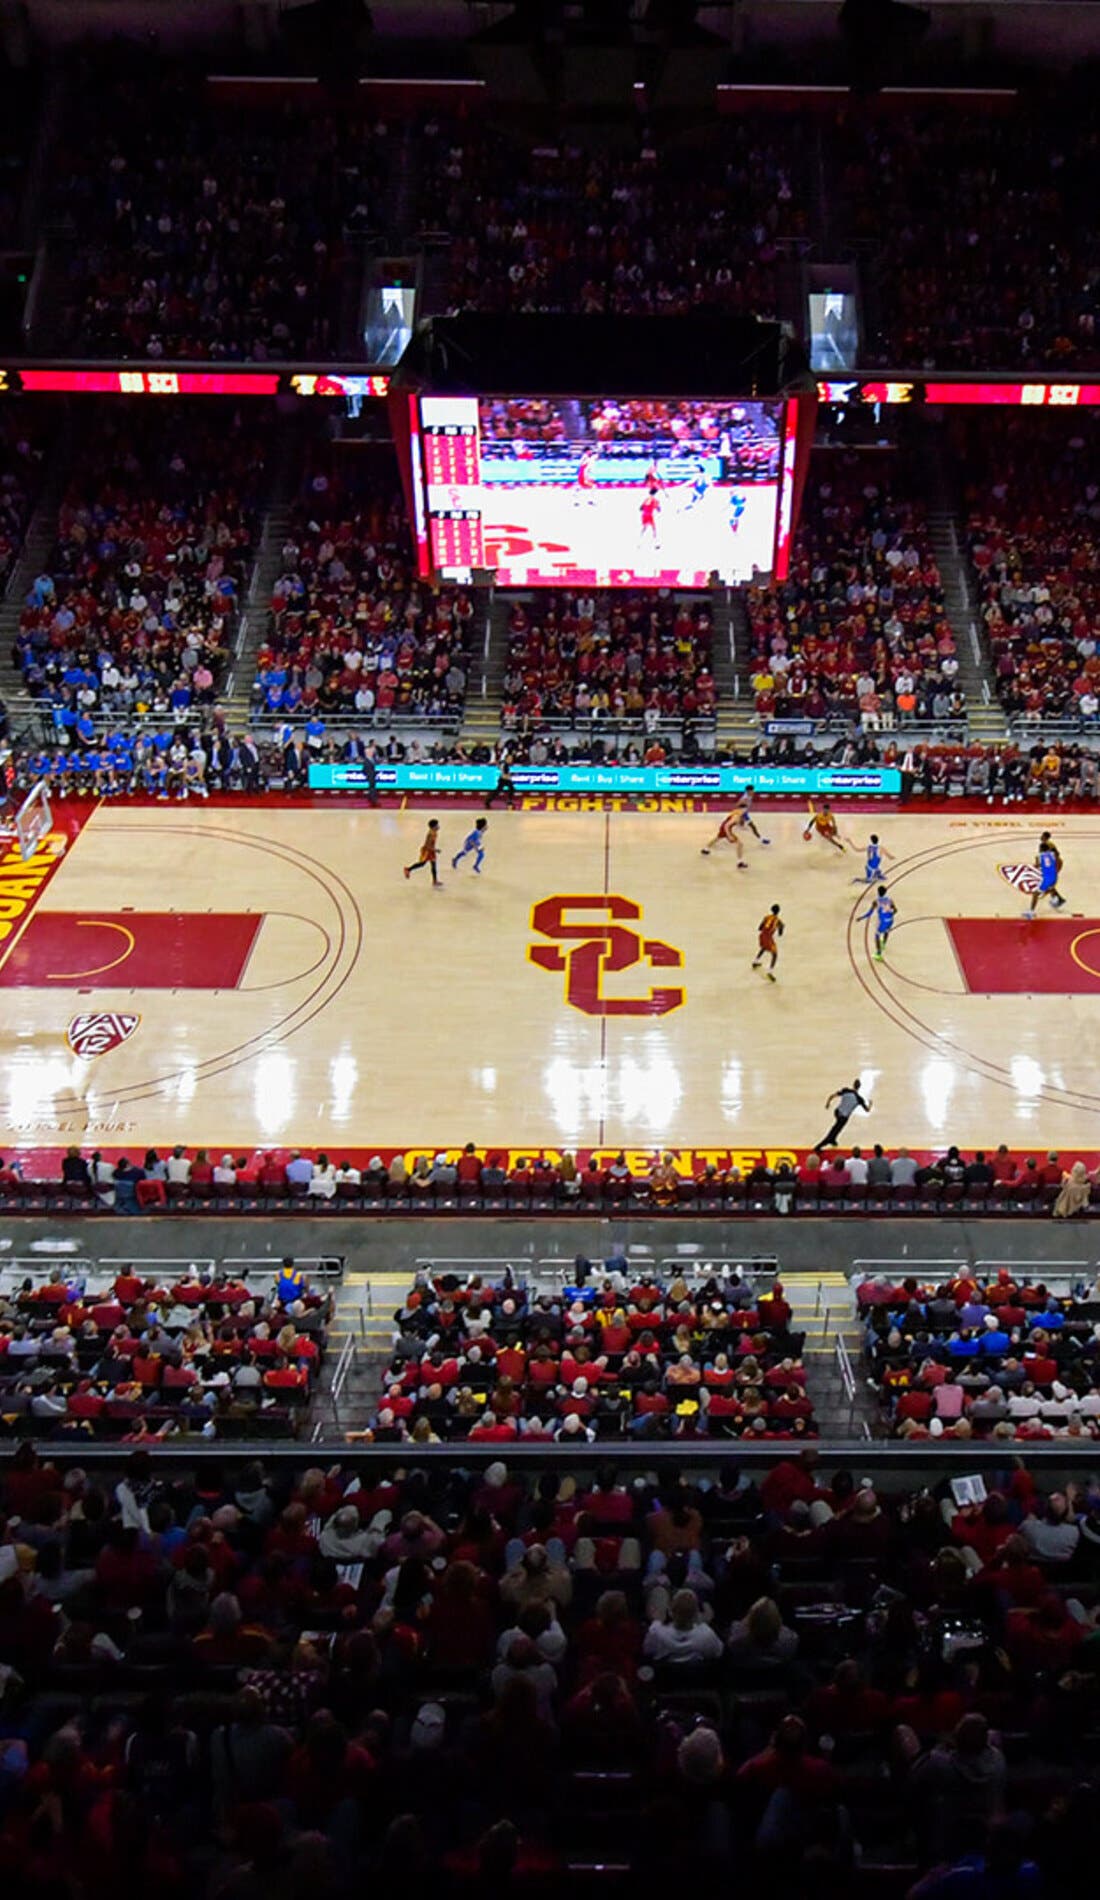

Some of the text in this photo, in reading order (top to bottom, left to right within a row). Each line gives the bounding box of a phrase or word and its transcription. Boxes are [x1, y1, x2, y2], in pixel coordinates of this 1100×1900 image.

[335, 772, 396, 782] enterrise
[409, 772, 482, 782] Rent Buy Share
[571, 774, 644, 784] Rent Buy Share
[659, 775, 720, 786] enterprise
[733, 775, 806, 785] Rent Buy Share
[820, 776, 881, 787] enterprise
[522, 797, 694, 813] FIGHT ON!
[526, 893, 687, 1017] SC
